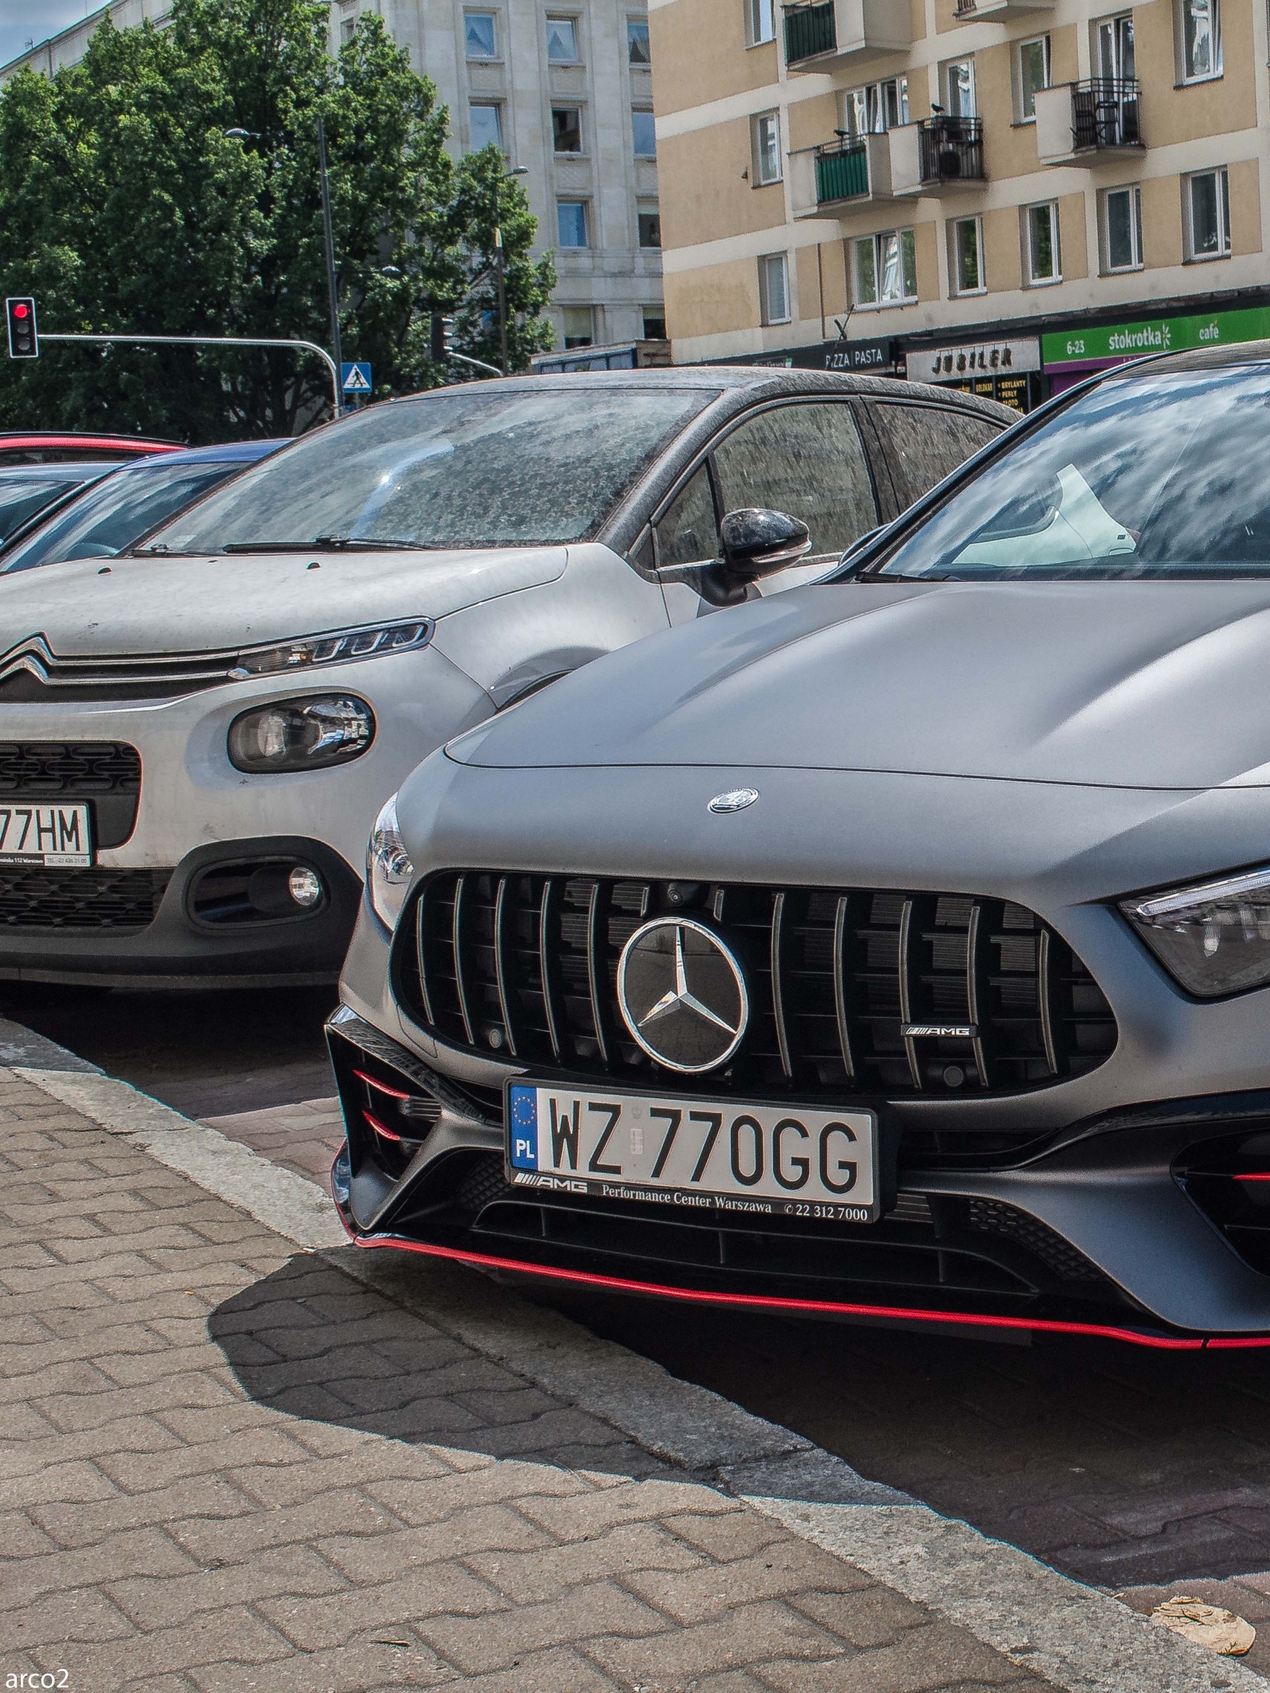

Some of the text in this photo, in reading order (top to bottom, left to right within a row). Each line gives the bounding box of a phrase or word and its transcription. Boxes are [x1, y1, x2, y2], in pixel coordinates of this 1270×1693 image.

[1108, 326, 1162, 350] stokrotka
[1199, 320, 1219, 341] café
[855, 348, 883, 365] PASTA
[1066, 340, 1085, 355] 6-23
[931, 347, 1012, 375] JUBILER
[0, 809, 81, 852] 77HM
[926, 1027, 970, 1036] AMG
[515, 1139, 535, 1159] PL
[549, 1097, 858, 1195] WZ 770GG
[537, 1173, 588, 1193] AMG
[602, 1184, 772, 1214] Performance Center Warszawa
[795, 1204, 868, 1221] 22 312 7000
